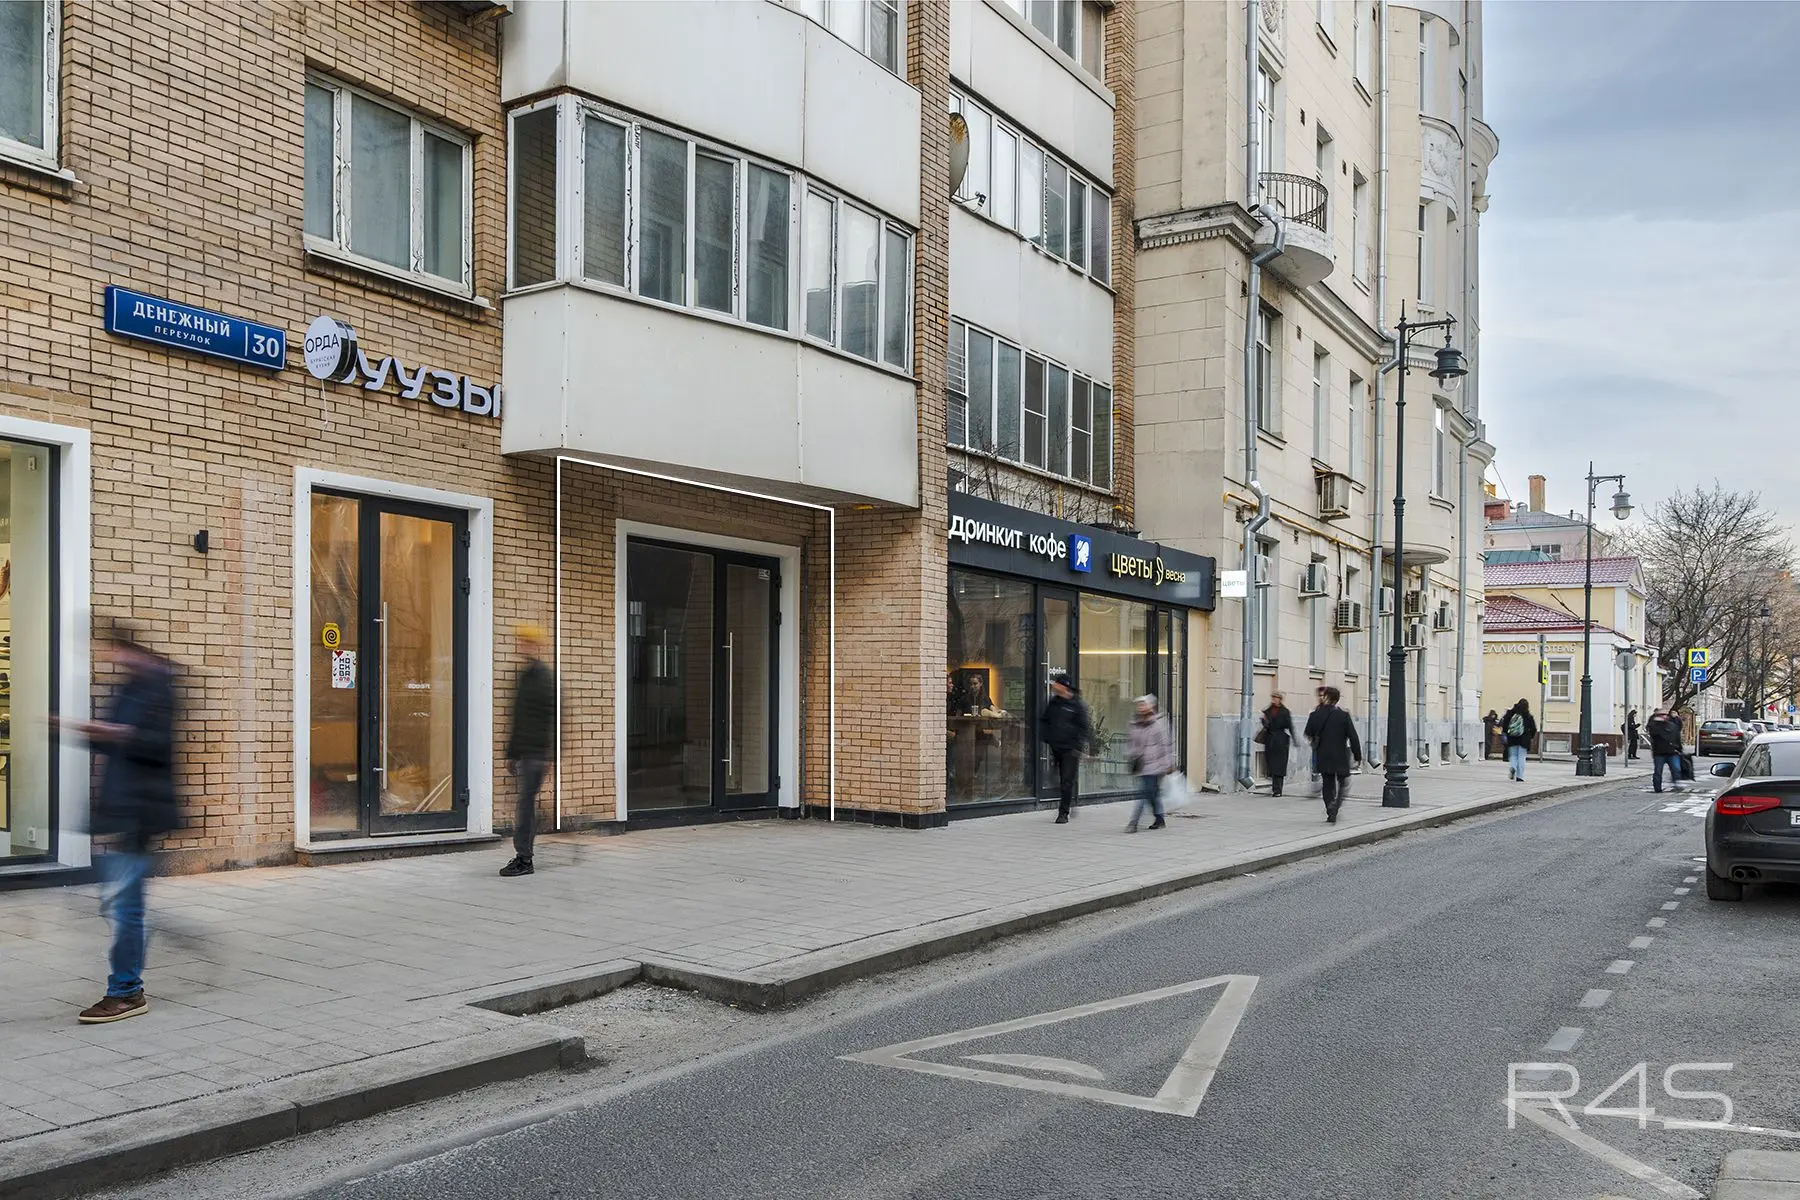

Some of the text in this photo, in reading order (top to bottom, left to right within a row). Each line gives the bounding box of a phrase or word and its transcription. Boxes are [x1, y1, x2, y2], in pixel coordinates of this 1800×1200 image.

[133, 301, 230, 337] ДЕНЕЖНЫЙ
[154, 325, 211, 345] ПЕРЕУЛОК
[252, 333, 279, 358] 30
[305, 333, 340, 353] ОРДА
[341, 348, 501, 417] УУЗЫ
[948, 514, 1067, 562] дринкит кофе
[1112, 552, 1186, 583] цветы весна
